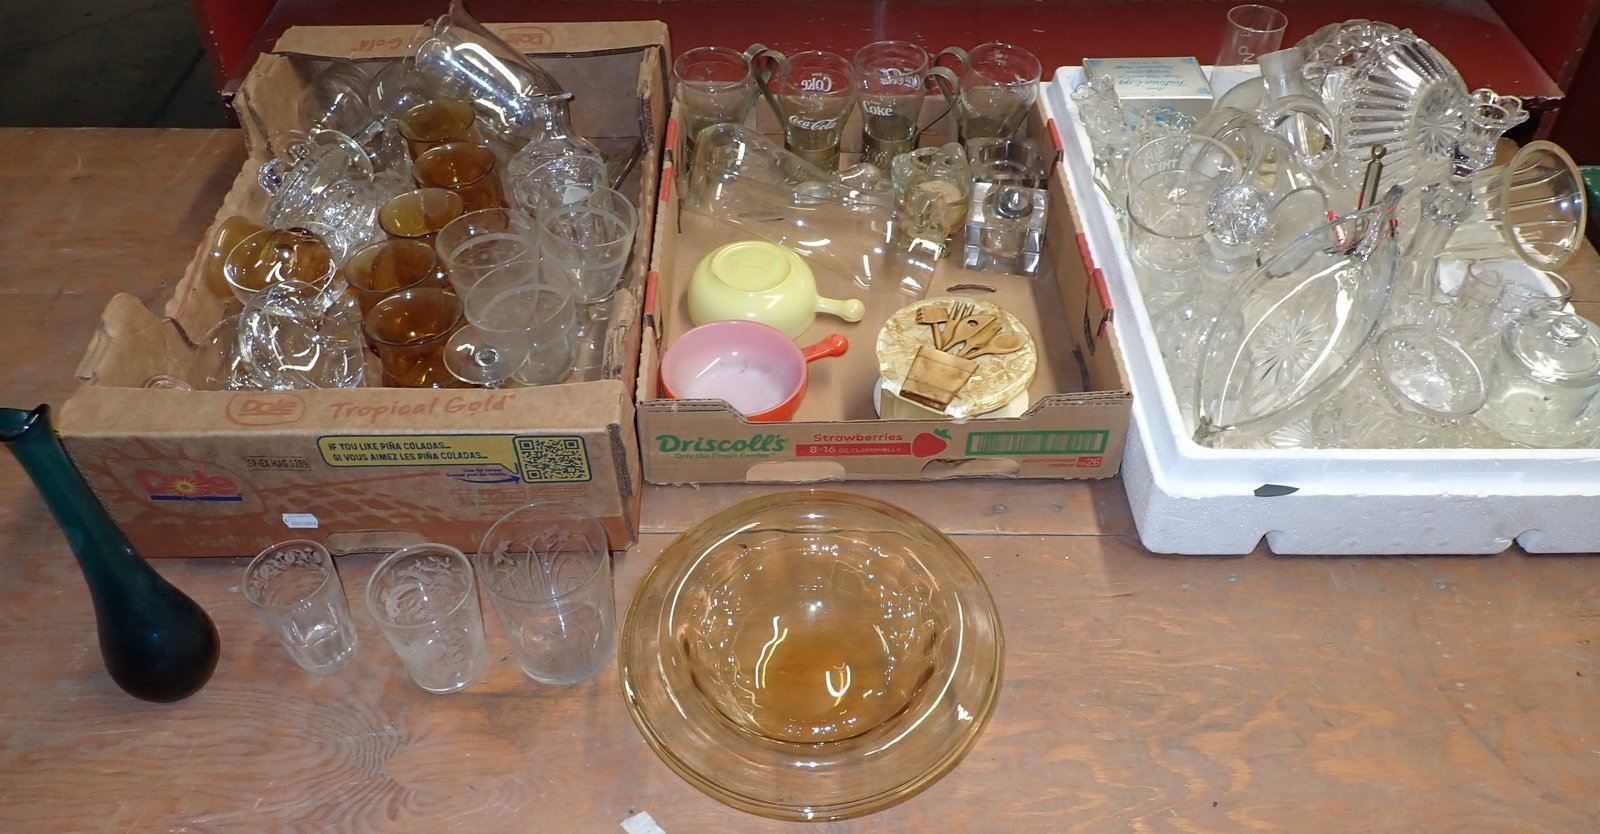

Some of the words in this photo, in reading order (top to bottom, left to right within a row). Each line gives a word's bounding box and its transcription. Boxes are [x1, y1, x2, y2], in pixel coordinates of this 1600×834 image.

[863, 100, 893, 116] Coke
[789, 115, 838, 131] Coca-Cola
[239, 399, 297, 415] Dole
[330, 397, 436, 423] Tropical
[444, 395, 506, 413] Gold
[655, 433, 790, 453] Driscoll's
[813, 433, 903, 442] Strawberries
[328, 443, 339, 451] IF
[340, 442, 358, 451] YOU
[360, 442, 379, 451] LIKE
[380, 440, 401, 450] PIÑA
[809, 446, 836, 454] 8-16
[333, 453, 342, 462] SI
[344, 453, 368, 461] VOUS
[371, 453, 398, 461] AIMEZ
[400, 453, 415, 461] LES
[417, 451, 440, 461] PIÑA
[1086, 457, 1100, 467] 26
